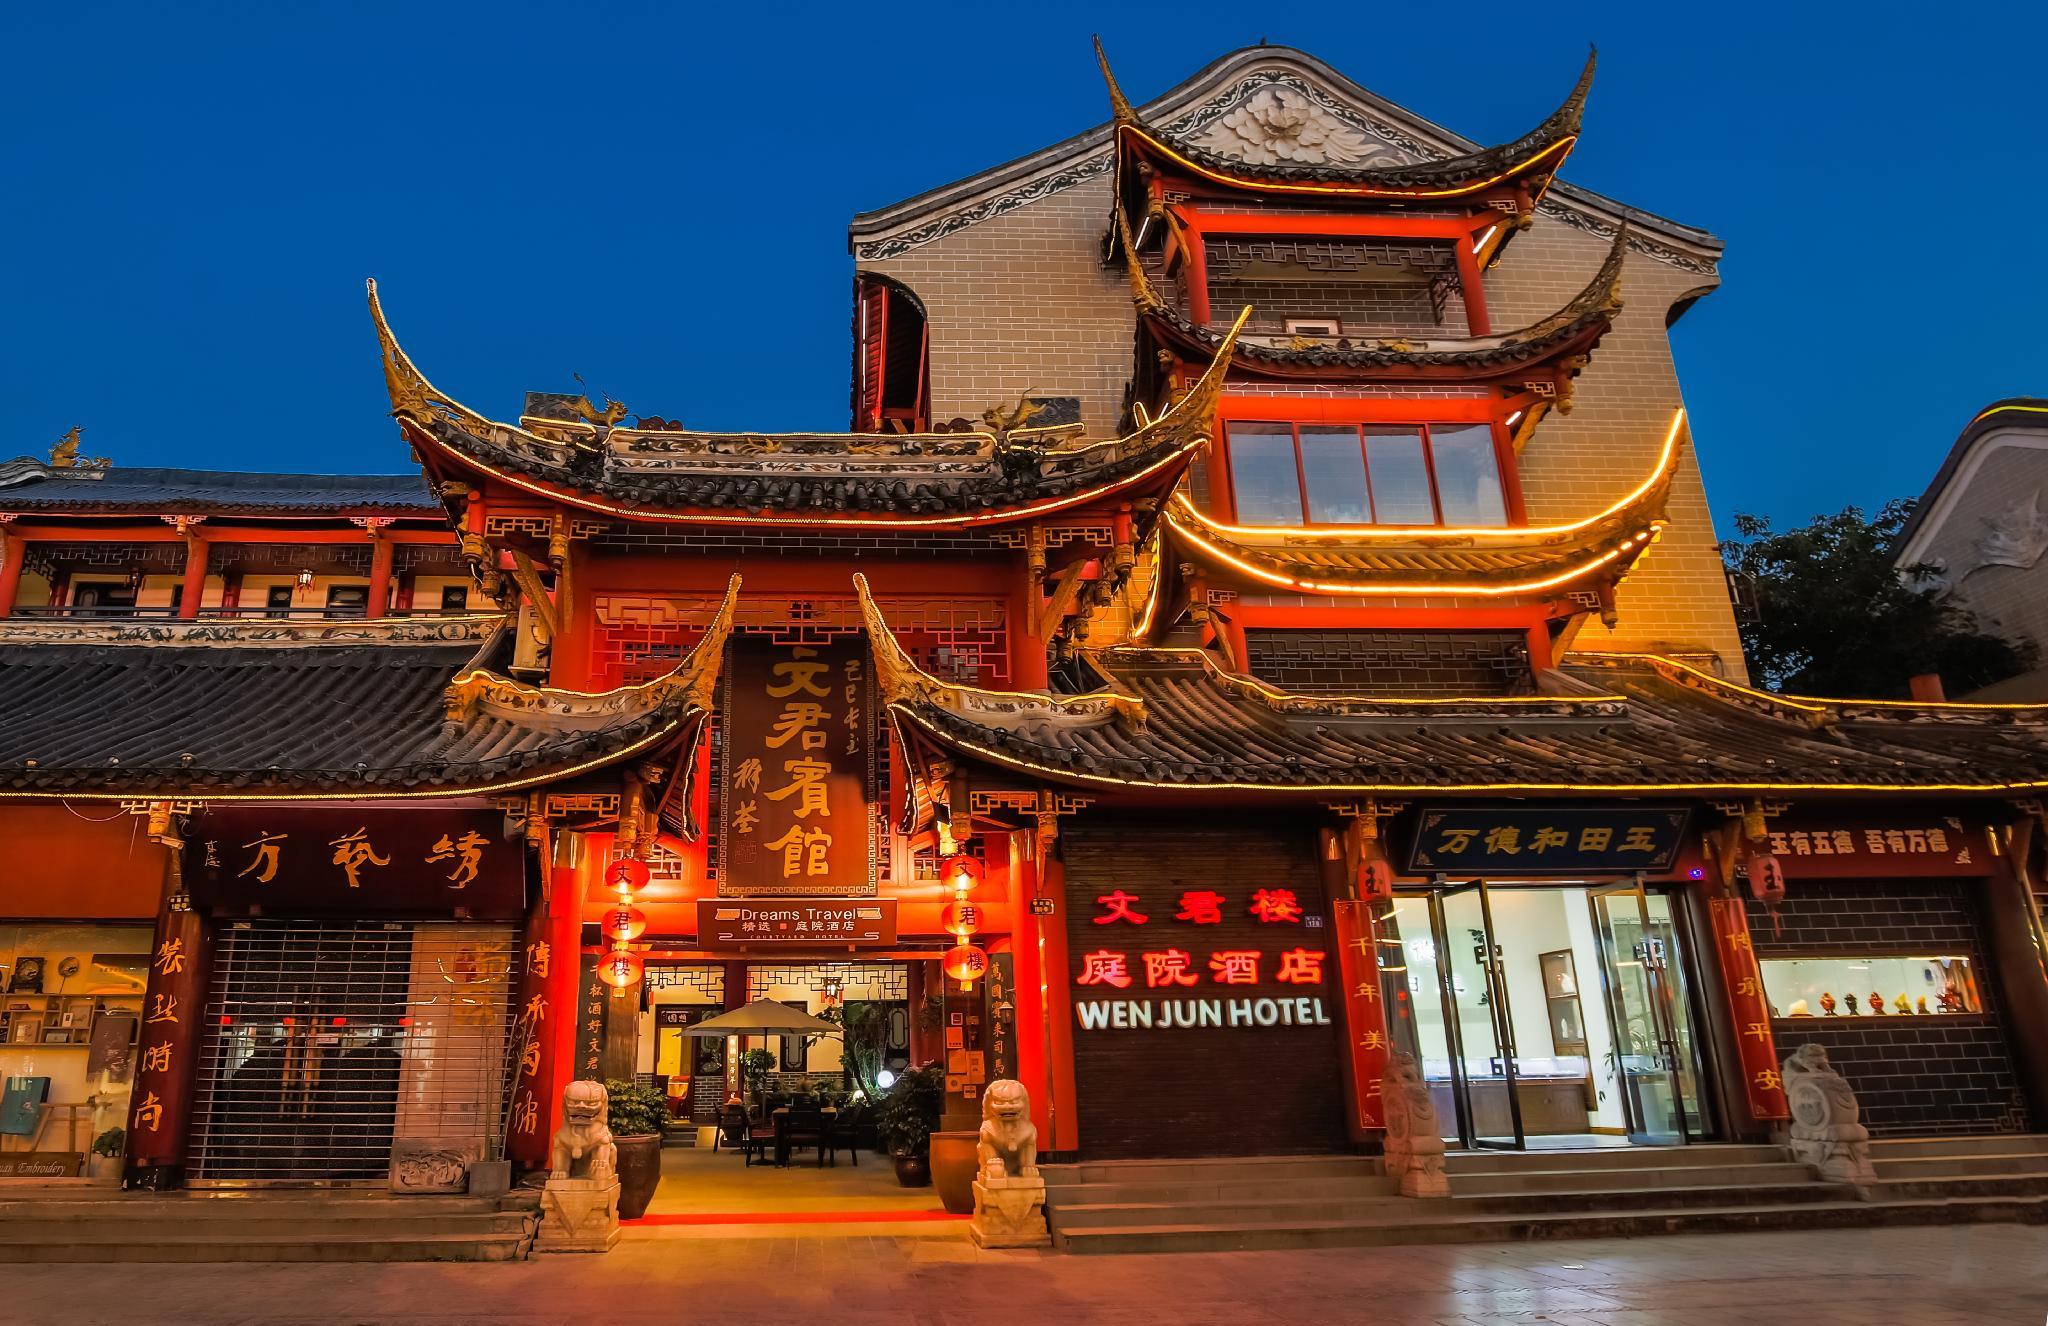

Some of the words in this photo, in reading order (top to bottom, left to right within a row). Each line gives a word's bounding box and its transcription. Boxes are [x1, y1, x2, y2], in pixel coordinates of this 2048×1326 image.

[763, 646, 832, 878] 文君賓館
[1436, 826, 1656, 855] 万德和田玉
[1768, 830, 1855, 855] 玉有五德
[1864, 828, 1949, 853] 吾有万德
[741, 908, 800, 921] Dreams
[805, 908, 856, 921] Travel
[1093, 889, 1303, 925] 文君楼
[741, 921, 772, 932] 精选
[795, 921, 855, 932] 庭院酒店
[1077, 948, 1325, 989] 庭院酒店
[1076, 1000, 1152, 1030] WEN
[1156, 998, 1223, 1028] JUN
[1227, 997, 1331, 1027] HOTEL
[1725, 932, 1782, 1091] 传承平安
[16, 1161, 66, 1177] Embroidery
